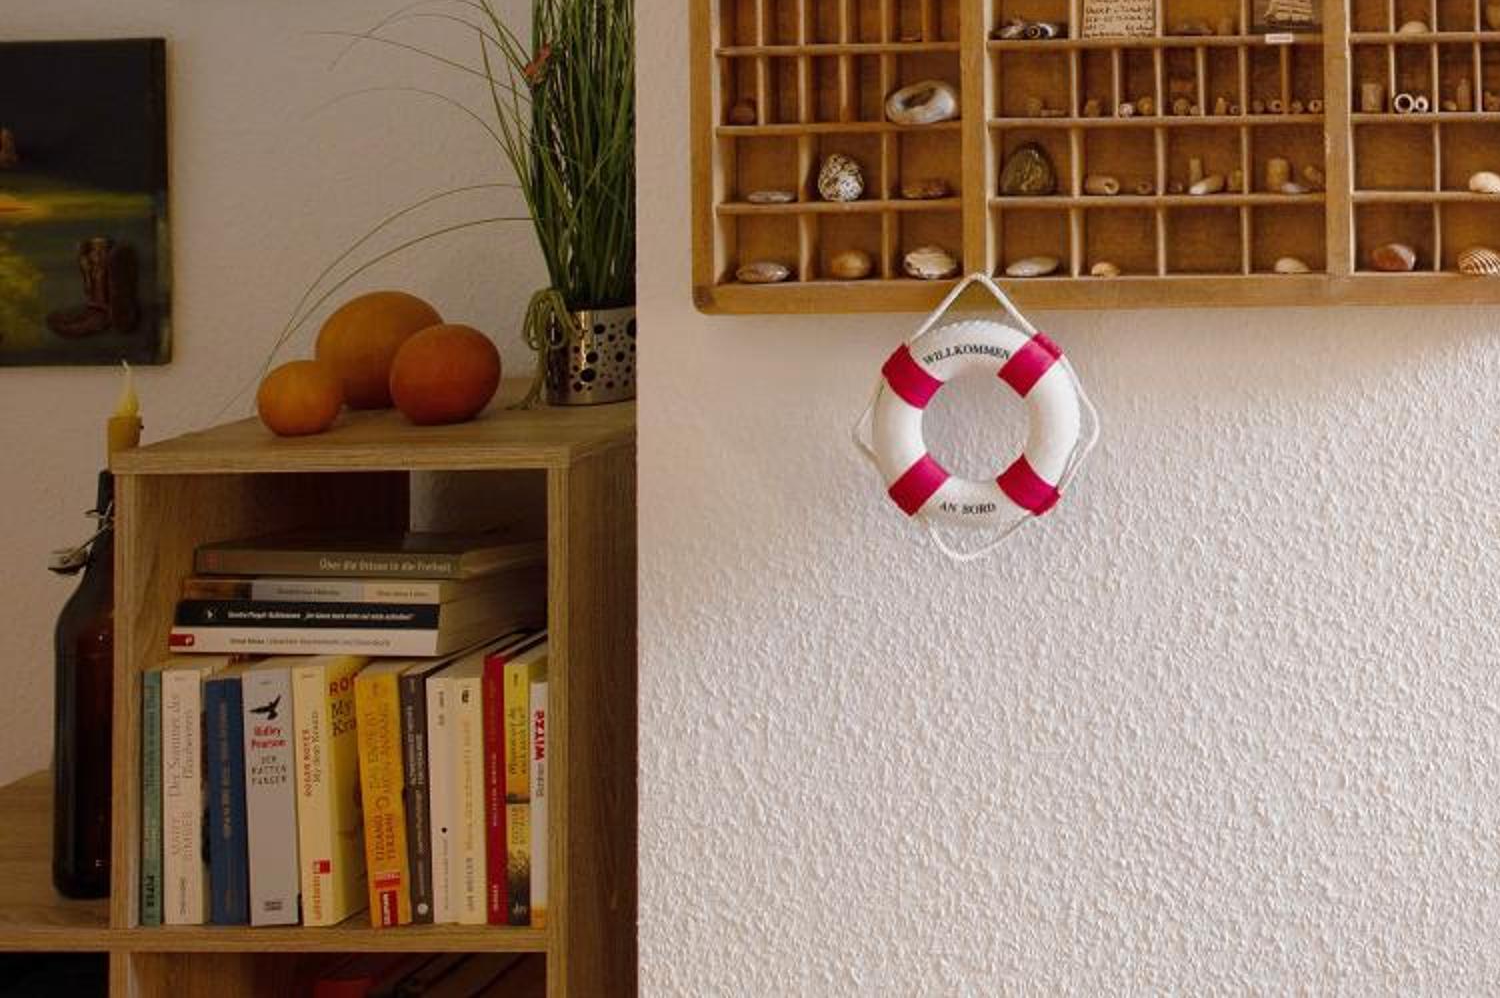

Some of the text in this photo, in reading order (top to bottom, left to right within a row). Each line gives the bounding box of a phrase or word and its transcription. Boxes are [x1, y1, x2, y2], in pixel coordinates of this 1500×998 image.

[922, 344, 1011, 365] WILLKOMMEN
[939, 501, 998, 515] AN BORD
